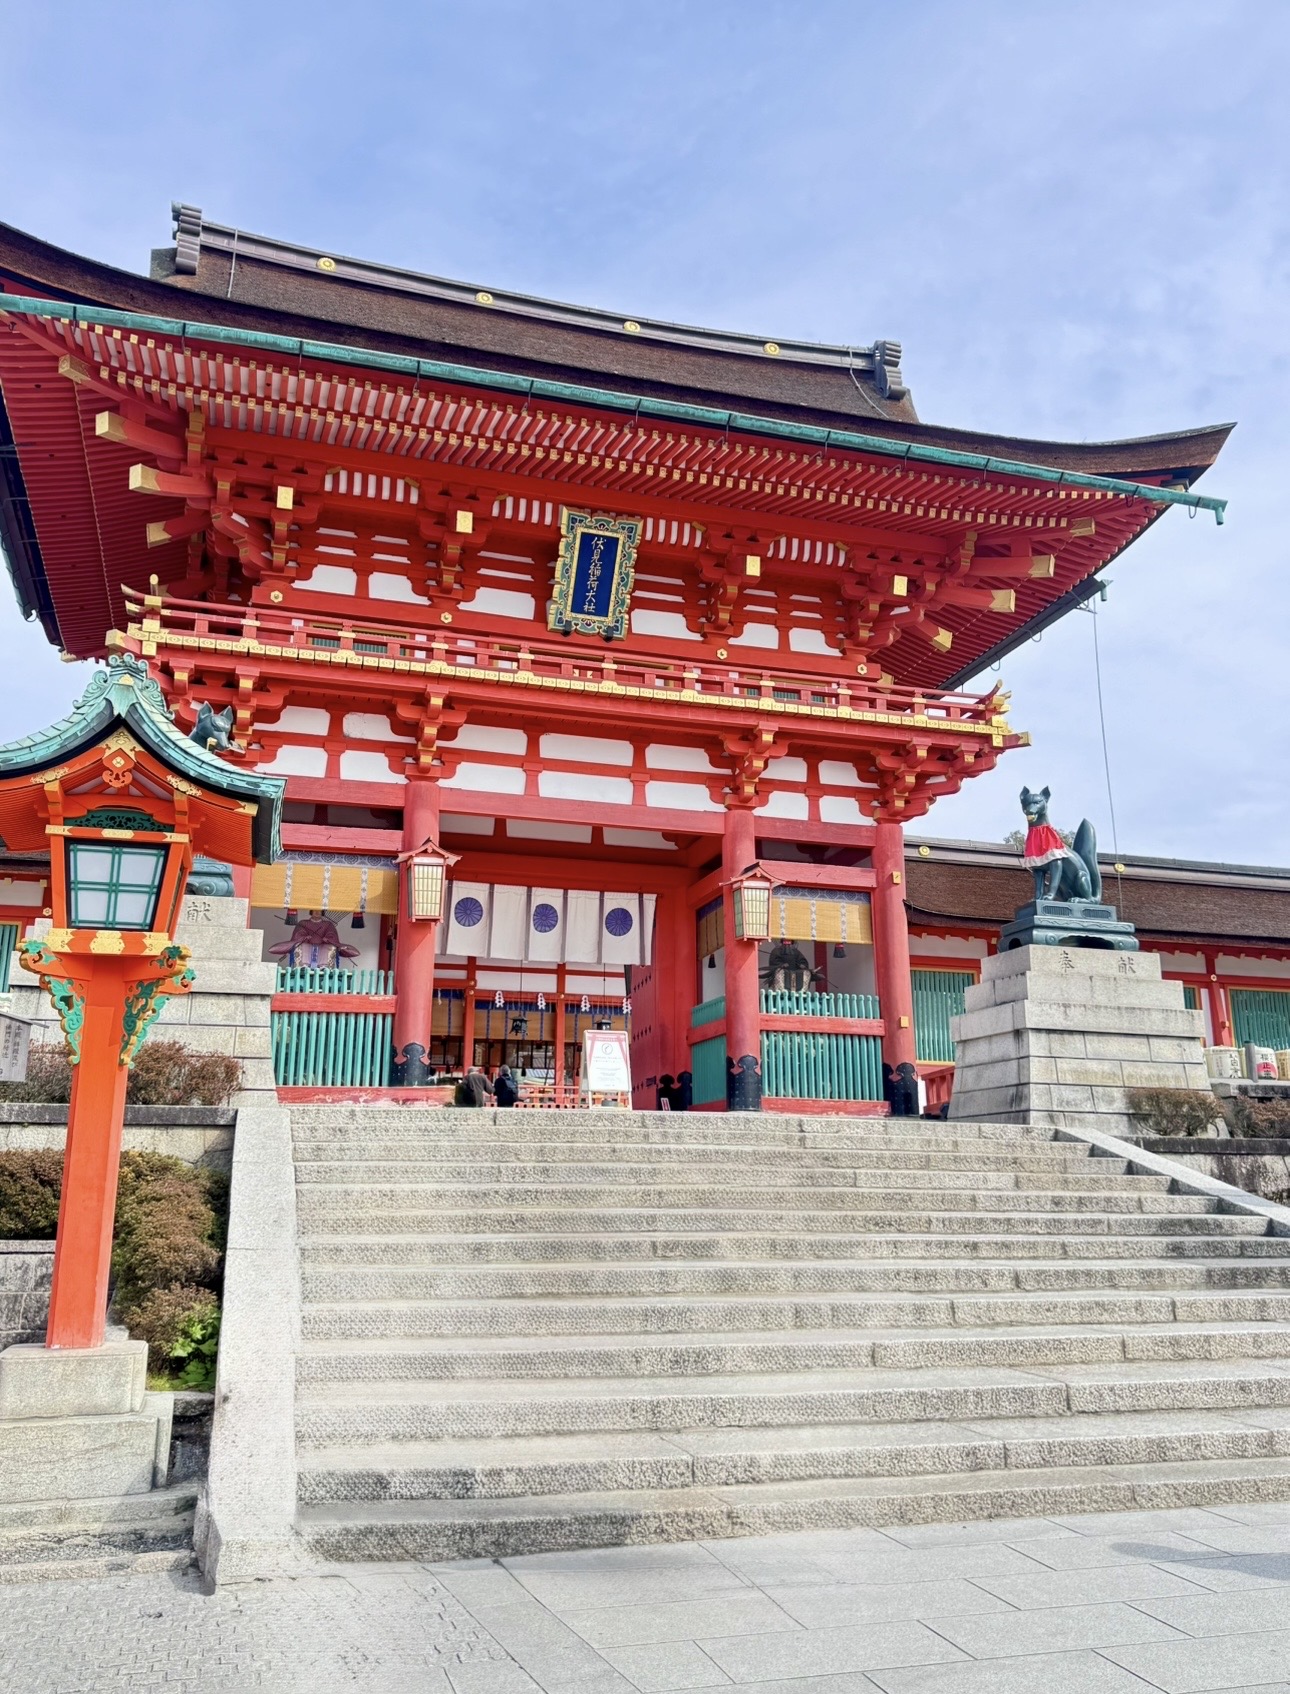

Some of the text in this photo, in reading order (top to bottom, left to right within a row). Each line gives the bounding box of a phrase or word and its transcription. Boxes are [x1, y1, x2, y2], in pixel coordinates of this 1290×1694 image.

[583, 536, 607, 613] 伏見稲荷大社
[186, 901, 212, 923] 献
